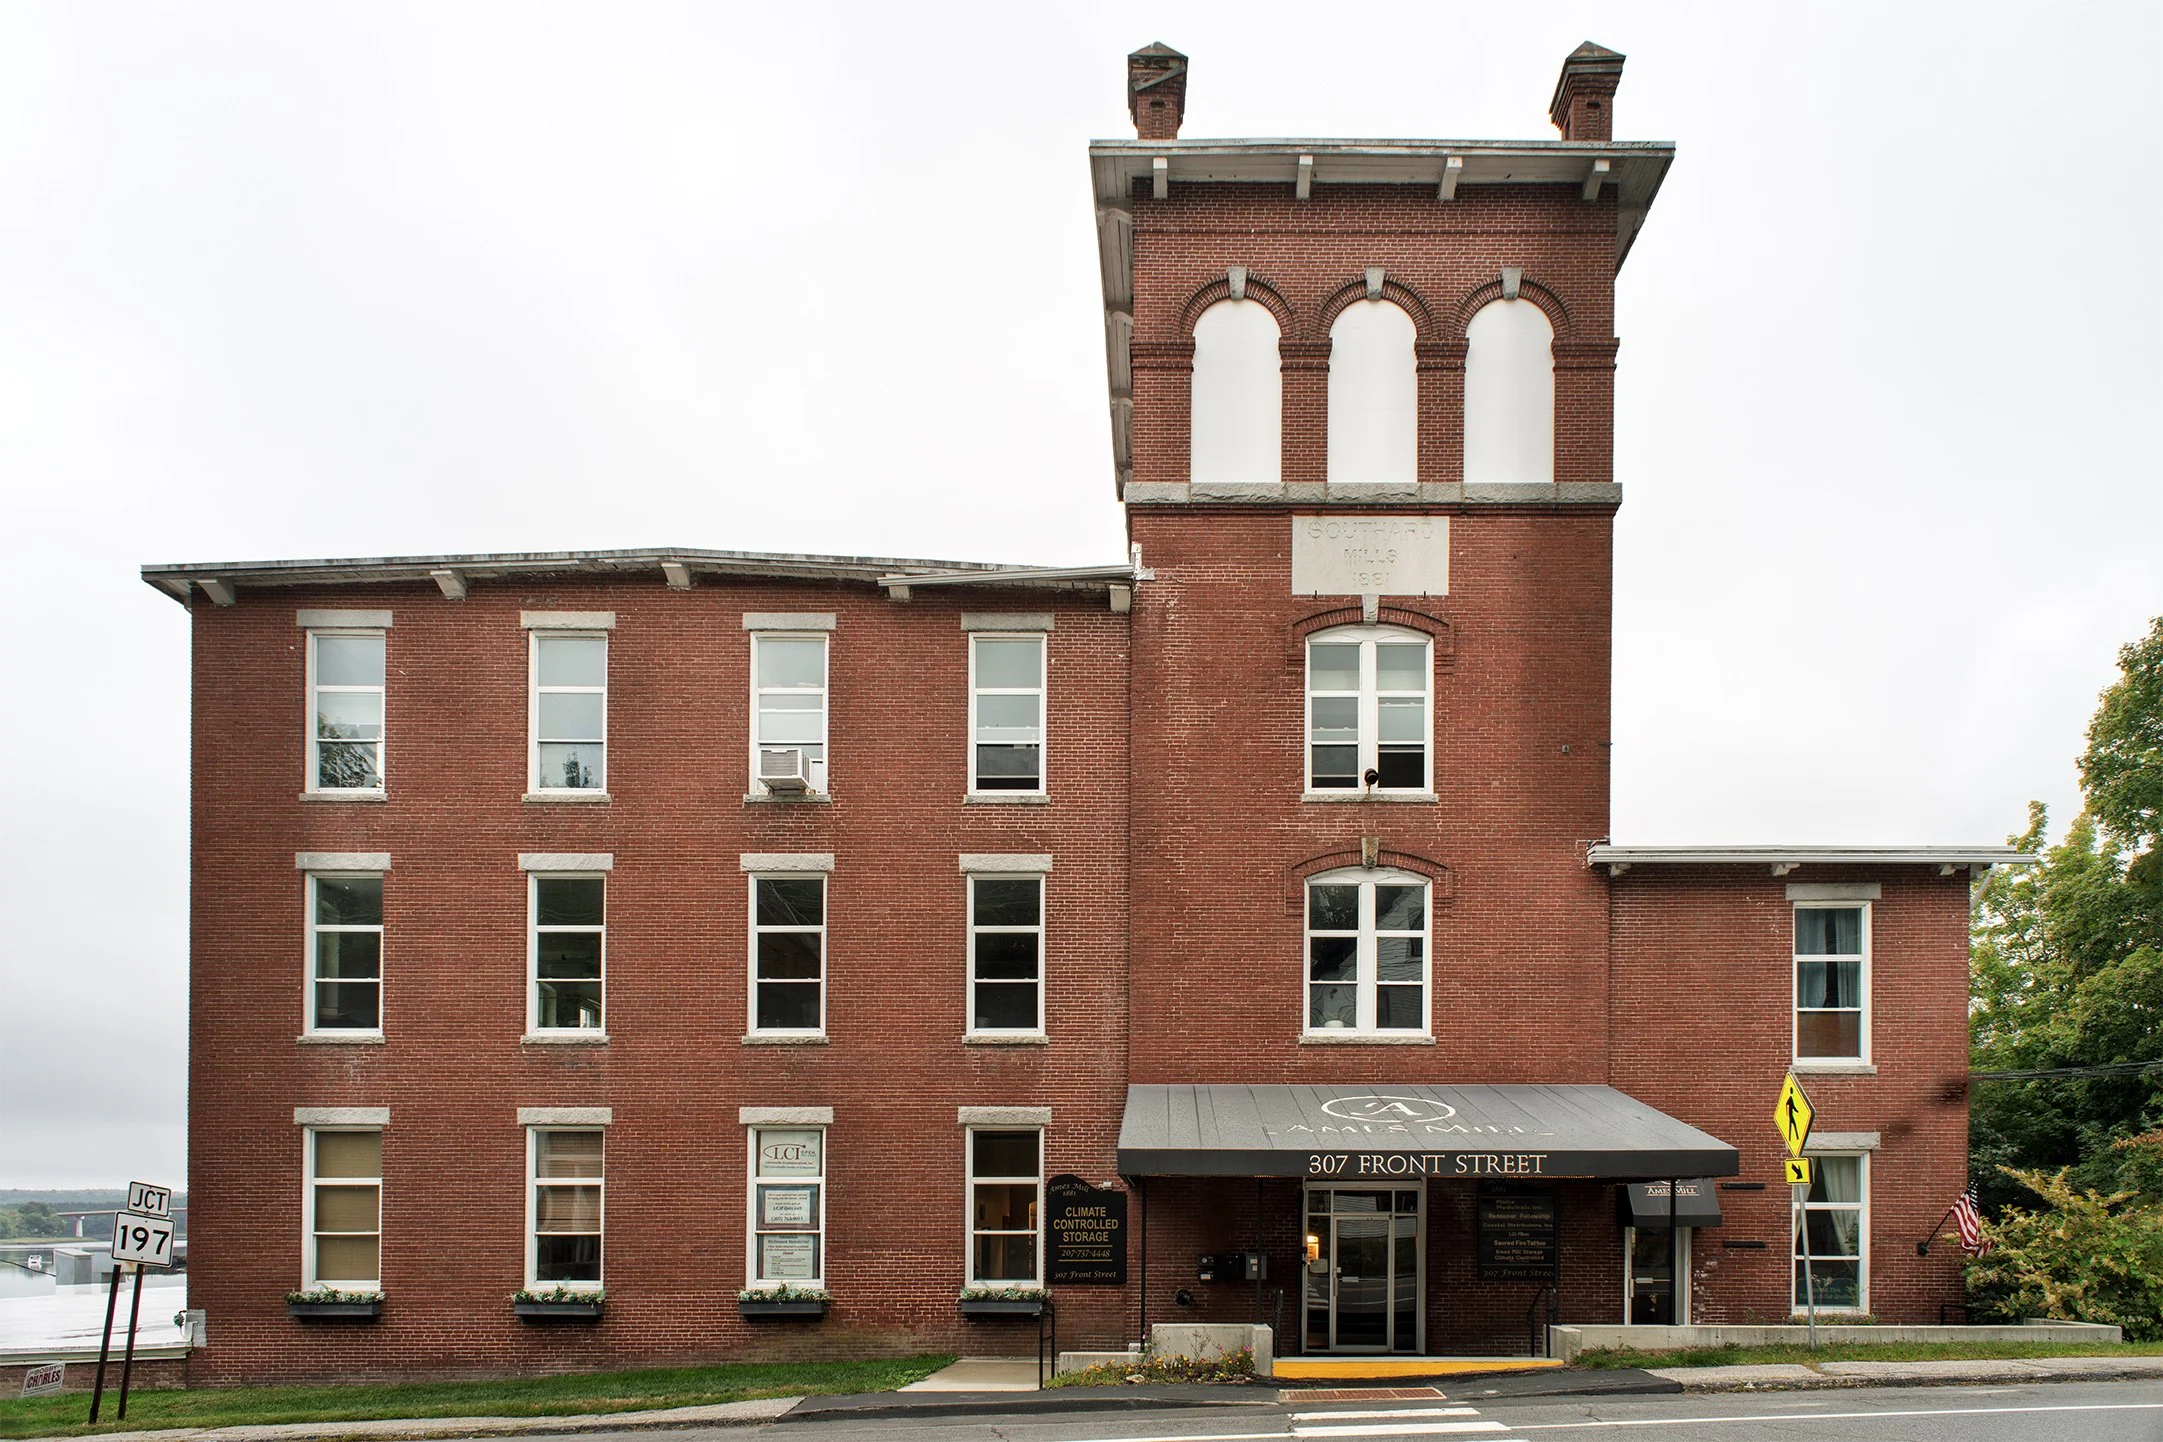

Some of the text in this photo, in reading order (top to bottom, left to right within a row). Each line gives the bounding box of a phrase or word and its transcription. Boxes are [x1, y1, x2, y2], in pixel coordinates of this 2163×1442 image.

[1307, 521, 1433, 540] SOUTHARD
[1344, 549, 1398, 564] MILLS
[773, 1147, 801, 1160] LCI
[1308, 1154, 1548, 1174] 307 FRONT STREET
[132, 1188, 167, 1211] JCT
[1065, 1206, 1107, 1217] CLIMATE
[1053, 1219, 1119, 1230] CONTROLLED
[120, 1225, 170, 1255] 197
[1062, 1231, 1109, 1242] STORAGE
[1055, 1270, 1117, 1279] 307 Front Street
[27, 1370, 61, 1388] CHARLES
